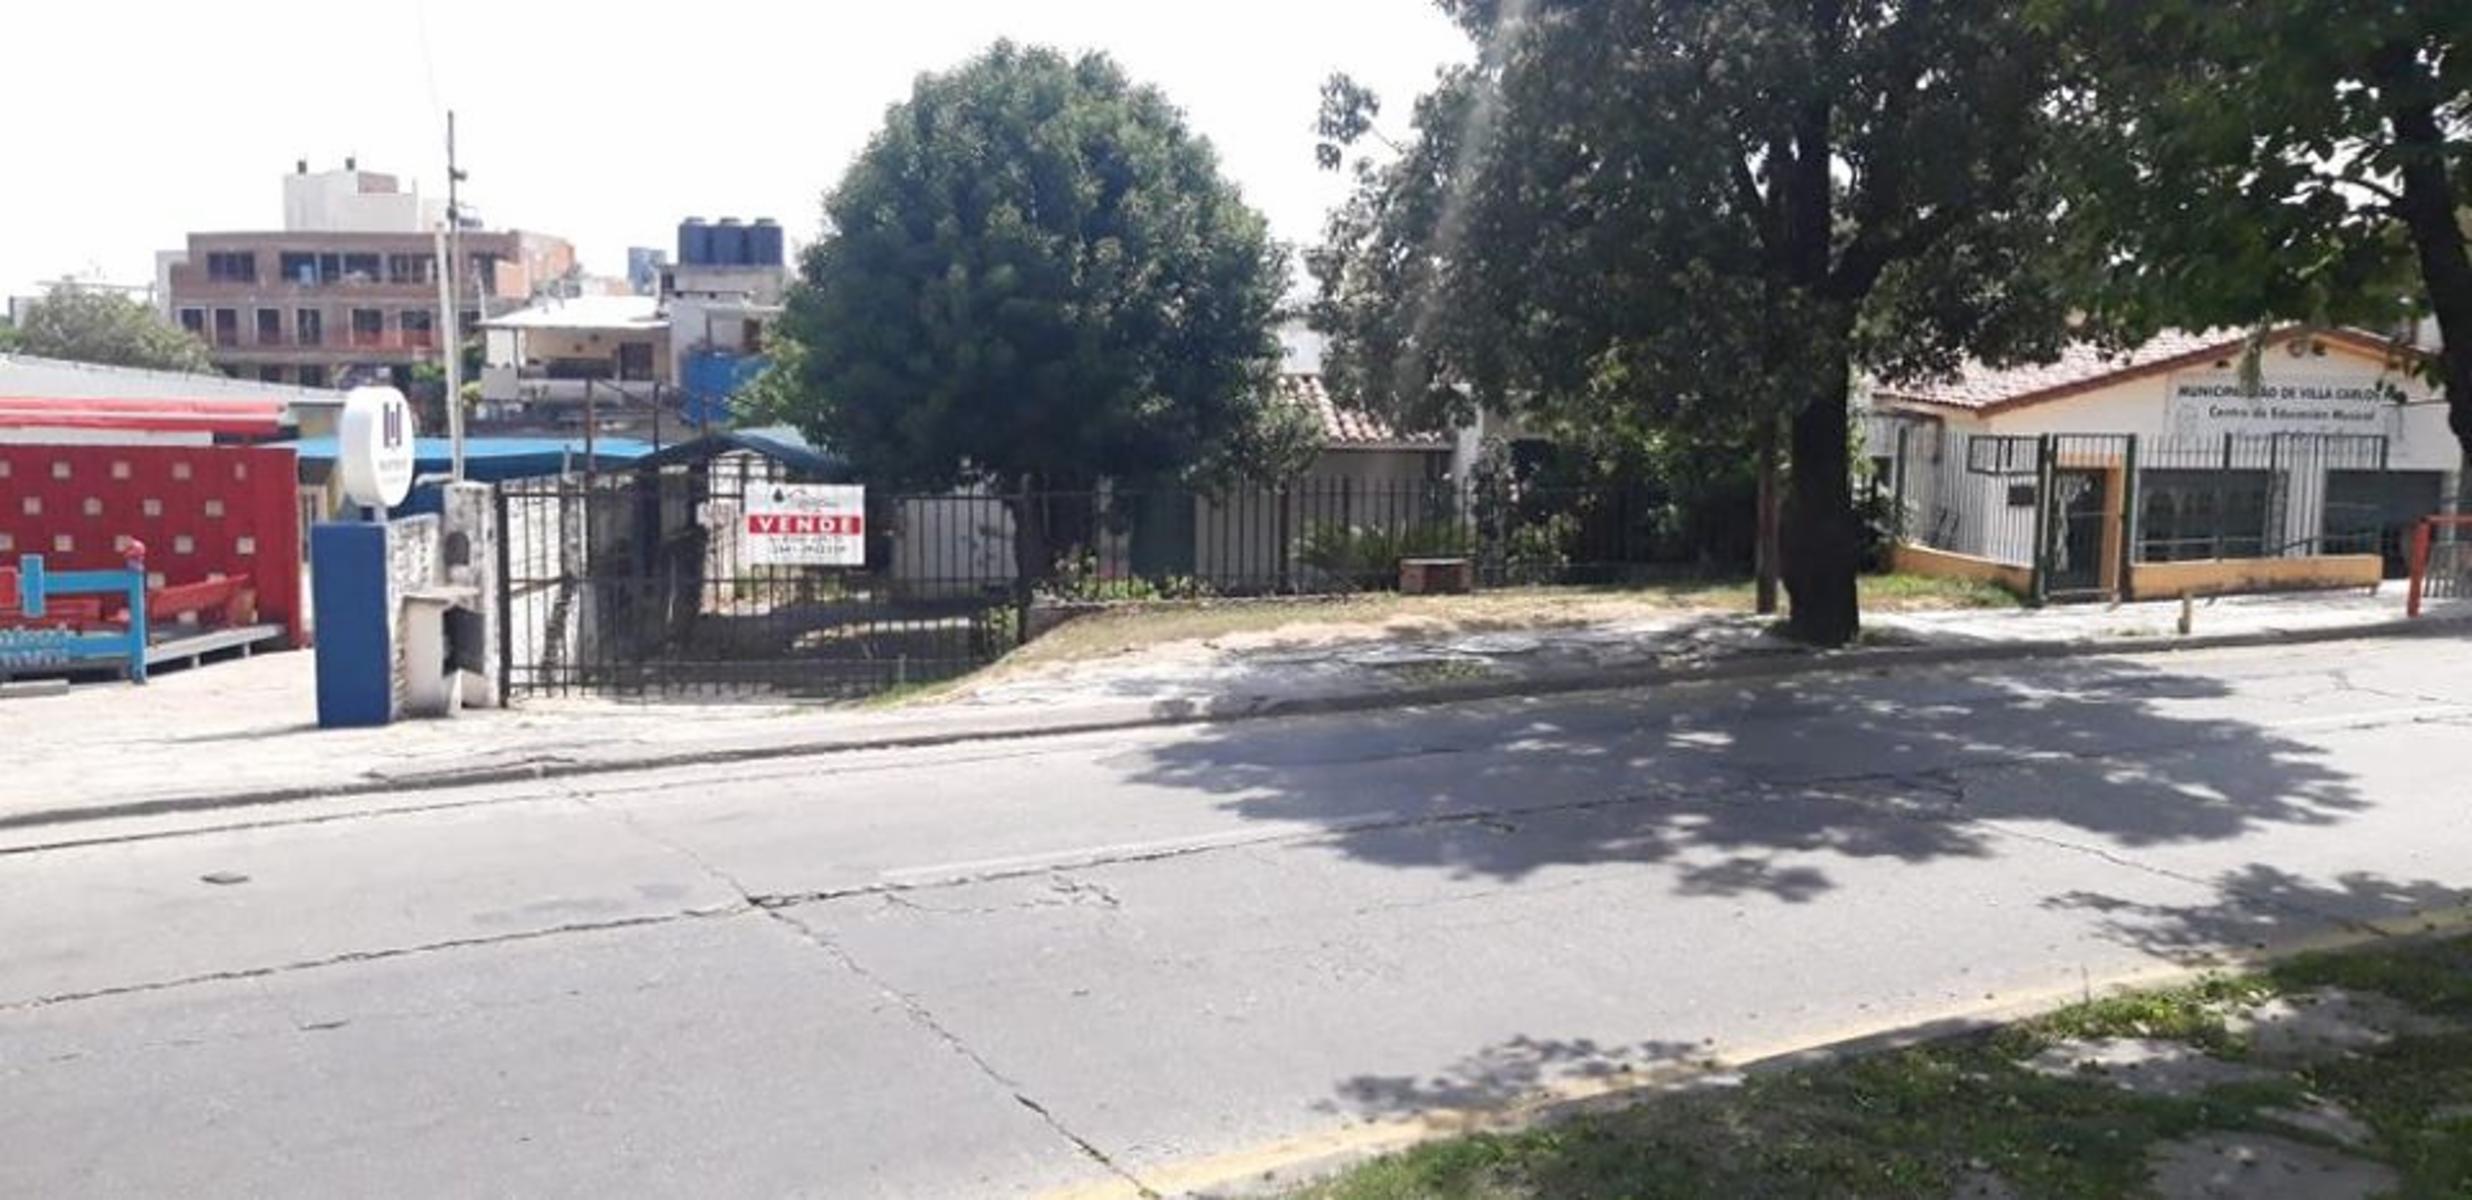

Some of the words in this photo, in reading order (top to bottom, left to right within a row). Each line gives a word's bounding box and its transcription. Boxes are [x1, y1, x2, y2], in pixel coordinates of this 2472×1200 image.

[2282, 386, 2295, 399] DE
[2300, 386, 2332, 399] VILLA
[2209, 405, 2248, 418] Centro
[2252, 407, 2267, 419] de
[2332, 409, 2375, 421] Musical
[758, 517, 853, 532] VENDE
